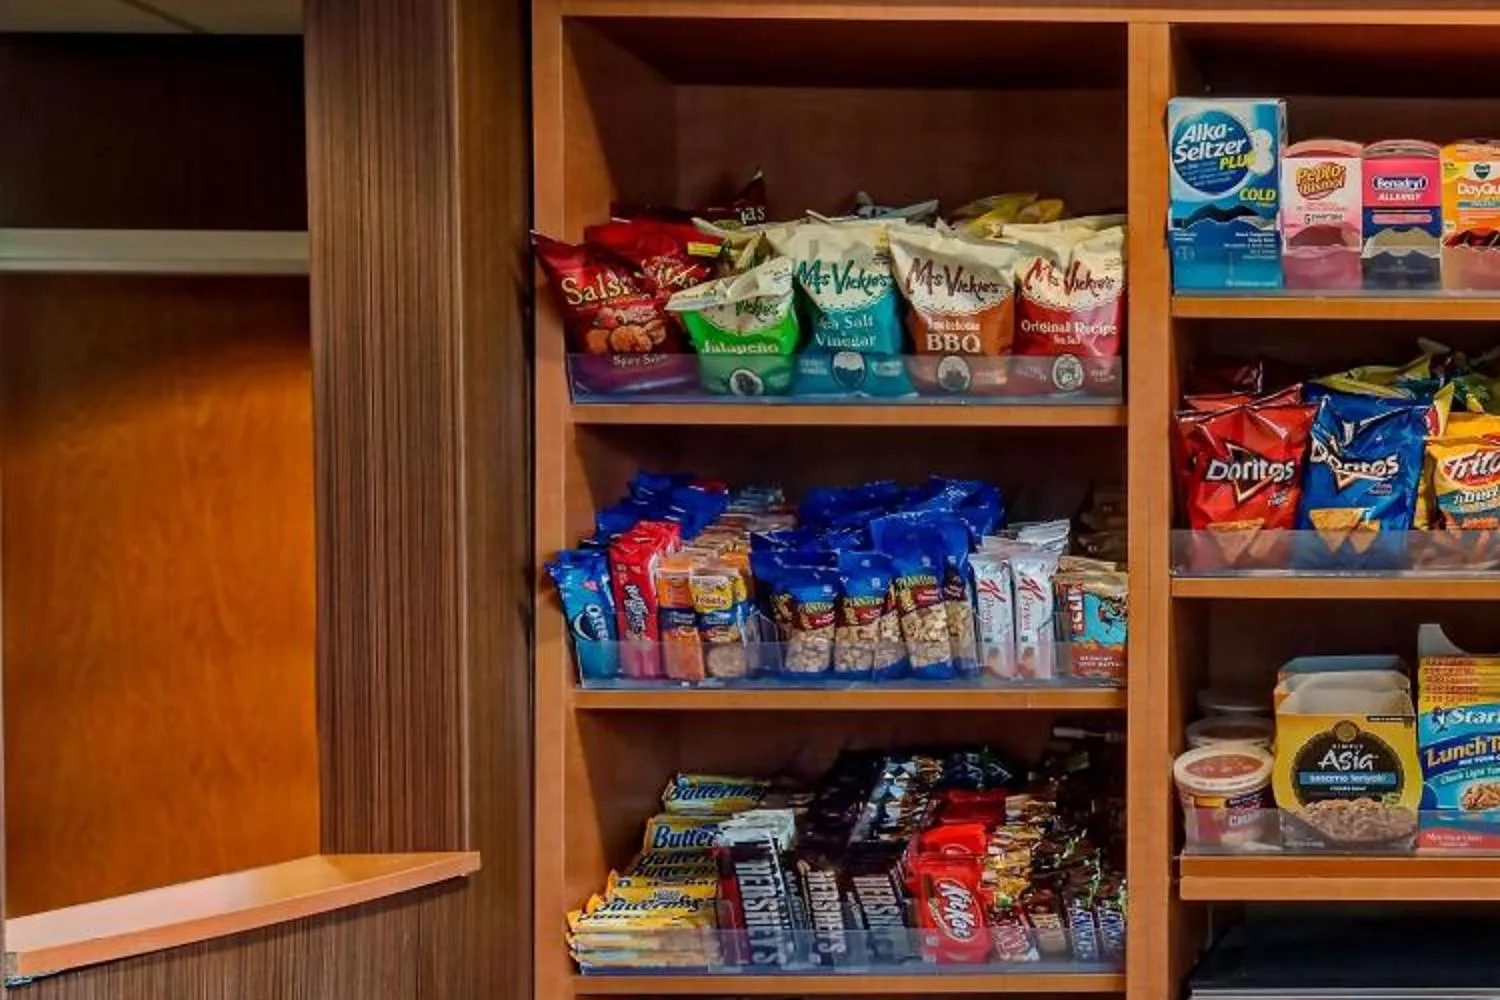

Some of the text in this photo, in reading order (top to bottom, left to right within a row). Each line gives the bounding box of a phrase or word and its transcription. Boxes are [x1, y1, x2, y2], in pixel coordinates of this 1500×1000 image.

[1177, 123, 1235, 145] Alka-
[1173, 137, 1248, 164] Seltzer
[1376, 177, 1424, 191] Benadryl
[1239, 187, 1277, 202] COLD
[843, 313, 874, 329] Salt
[1020, 318, 1118, 336] Original Recipe
[815, 333, 877, 348] Vinegar
[926, 333, 982, 353] BBQ
[1311, 440, 1400, 478] Doritos
[1205, 458, 1295, 482] Doritos
[1317, 750, 1376, 771] Asia
[1425, 735, 1486, 768] Lunch
[1466, 768, 1485, 781] Light
